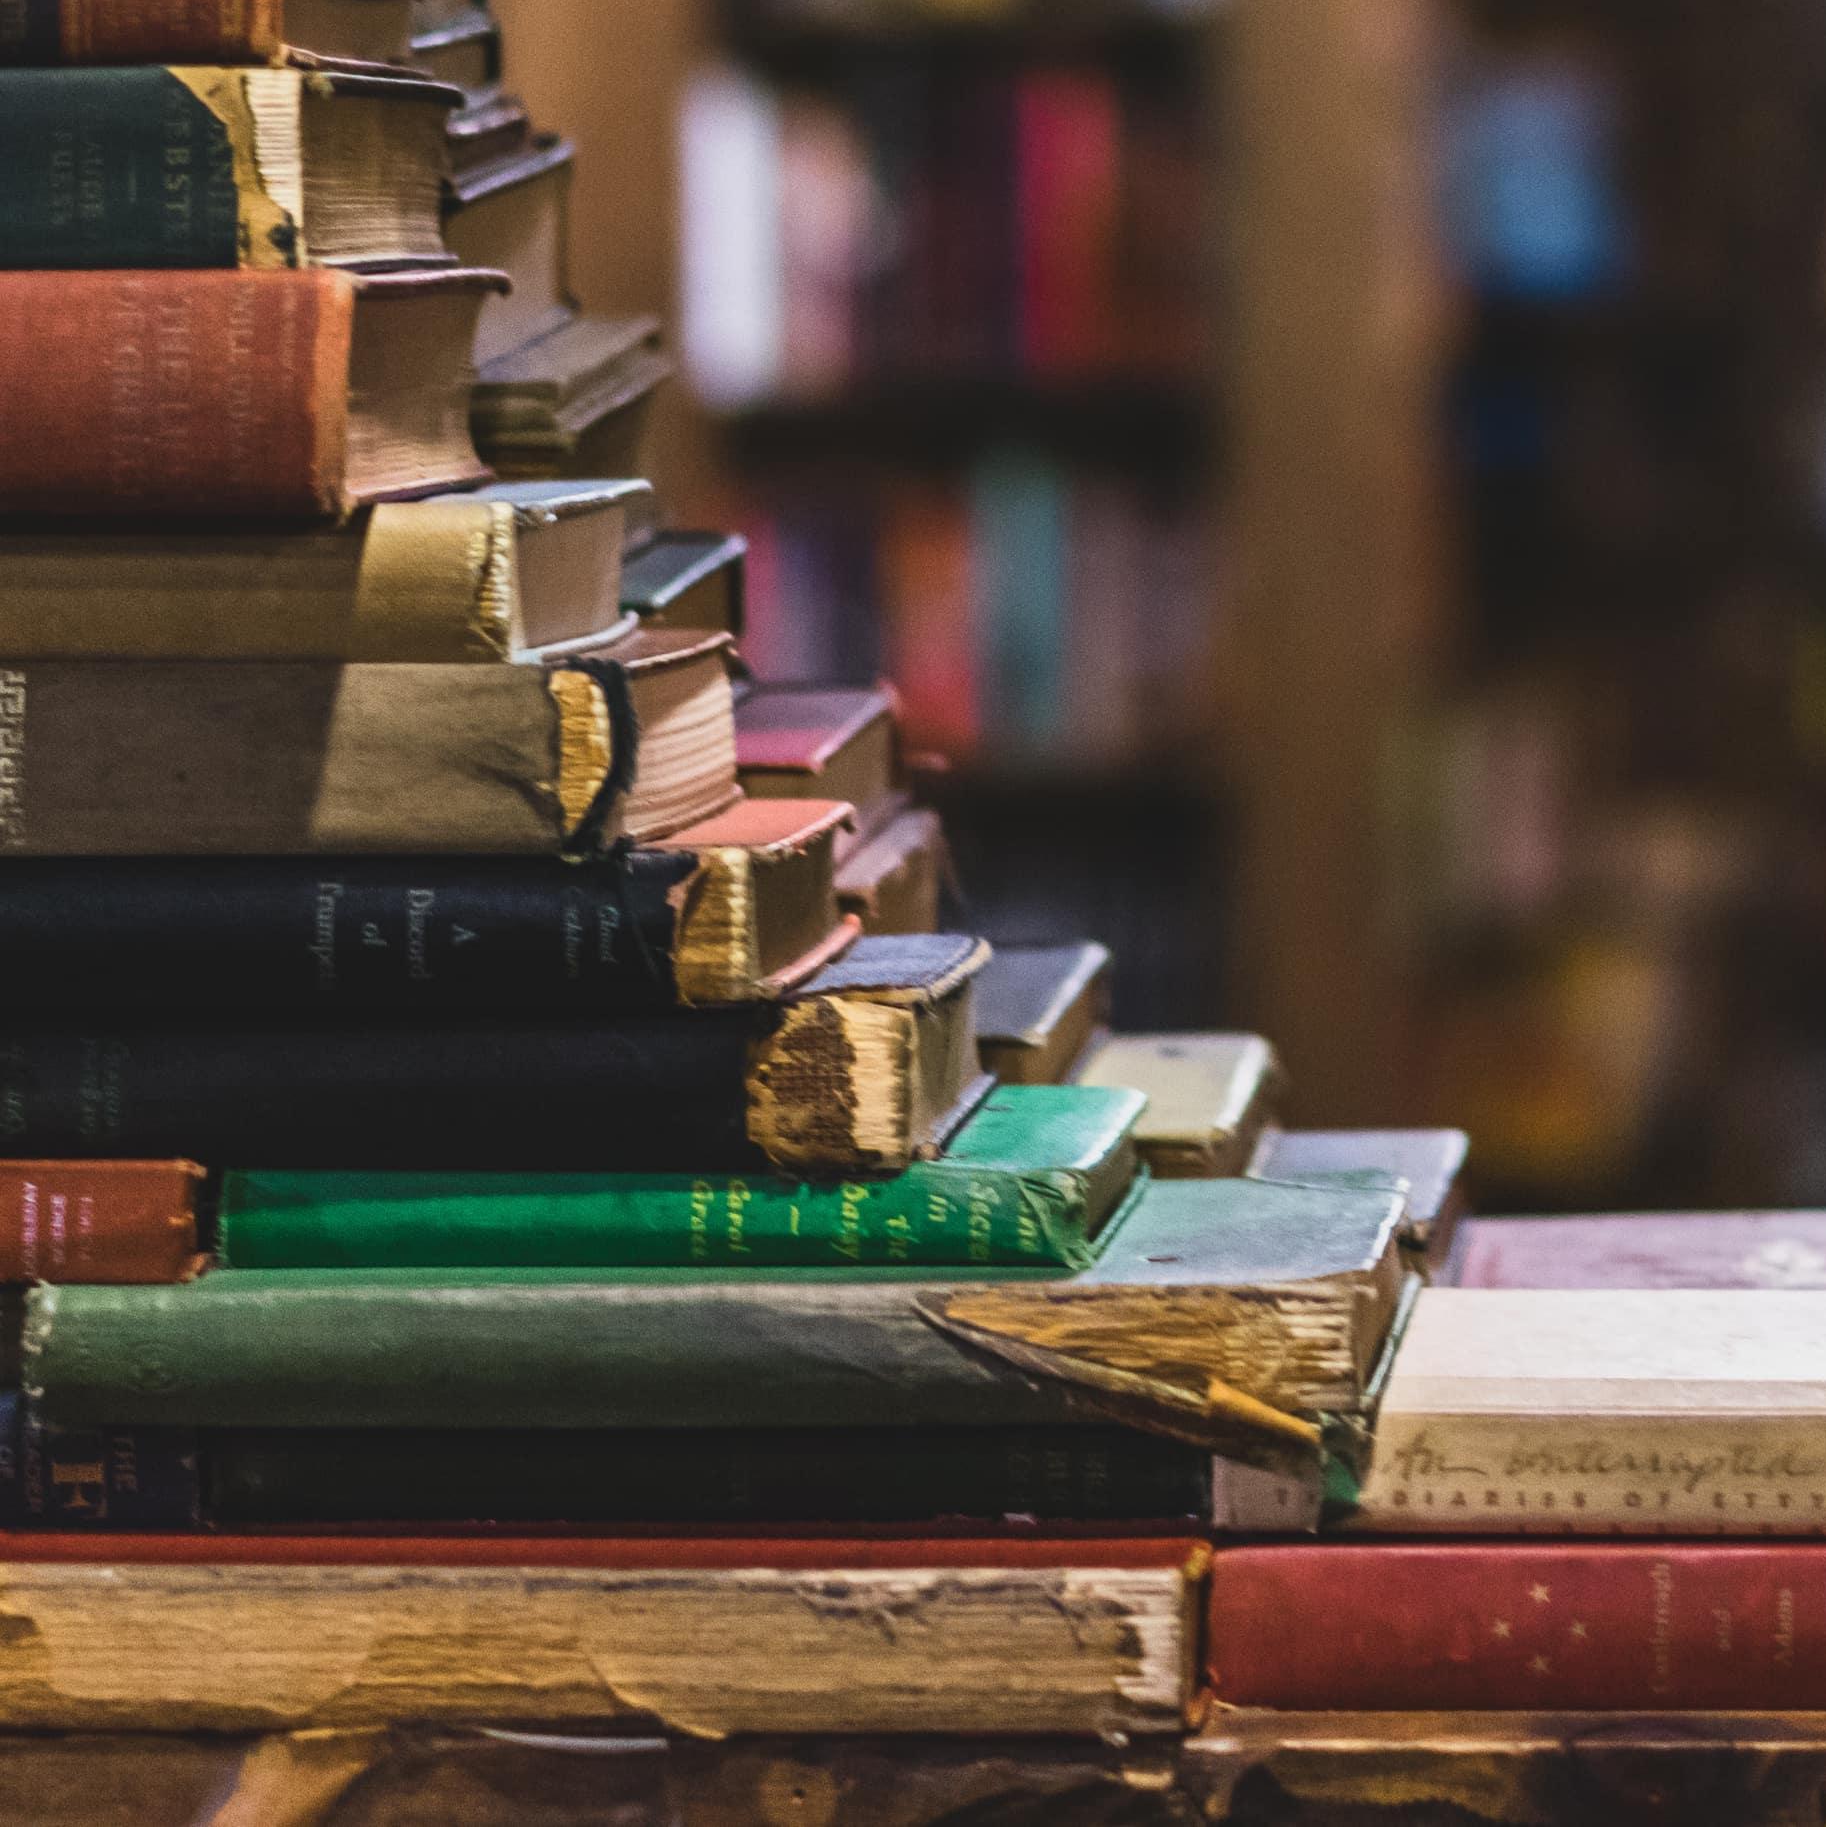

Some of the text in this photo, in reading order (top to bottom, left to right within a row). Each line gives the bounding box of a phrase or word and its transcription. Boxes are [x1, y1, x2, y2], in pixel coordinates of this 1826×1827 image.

[726, 1179, 752, 1253] Carol
[829, 1183, 870, 1261] Daisy
[928, 1194, 958, 1223] in
[885, 1213, 921, 1261] the
[1391, 1489, 1588, 1509] DIARIES
[1623, 1490, 1670, 1509] OF
[1712, 1490, 1825, 1510] ETTY
